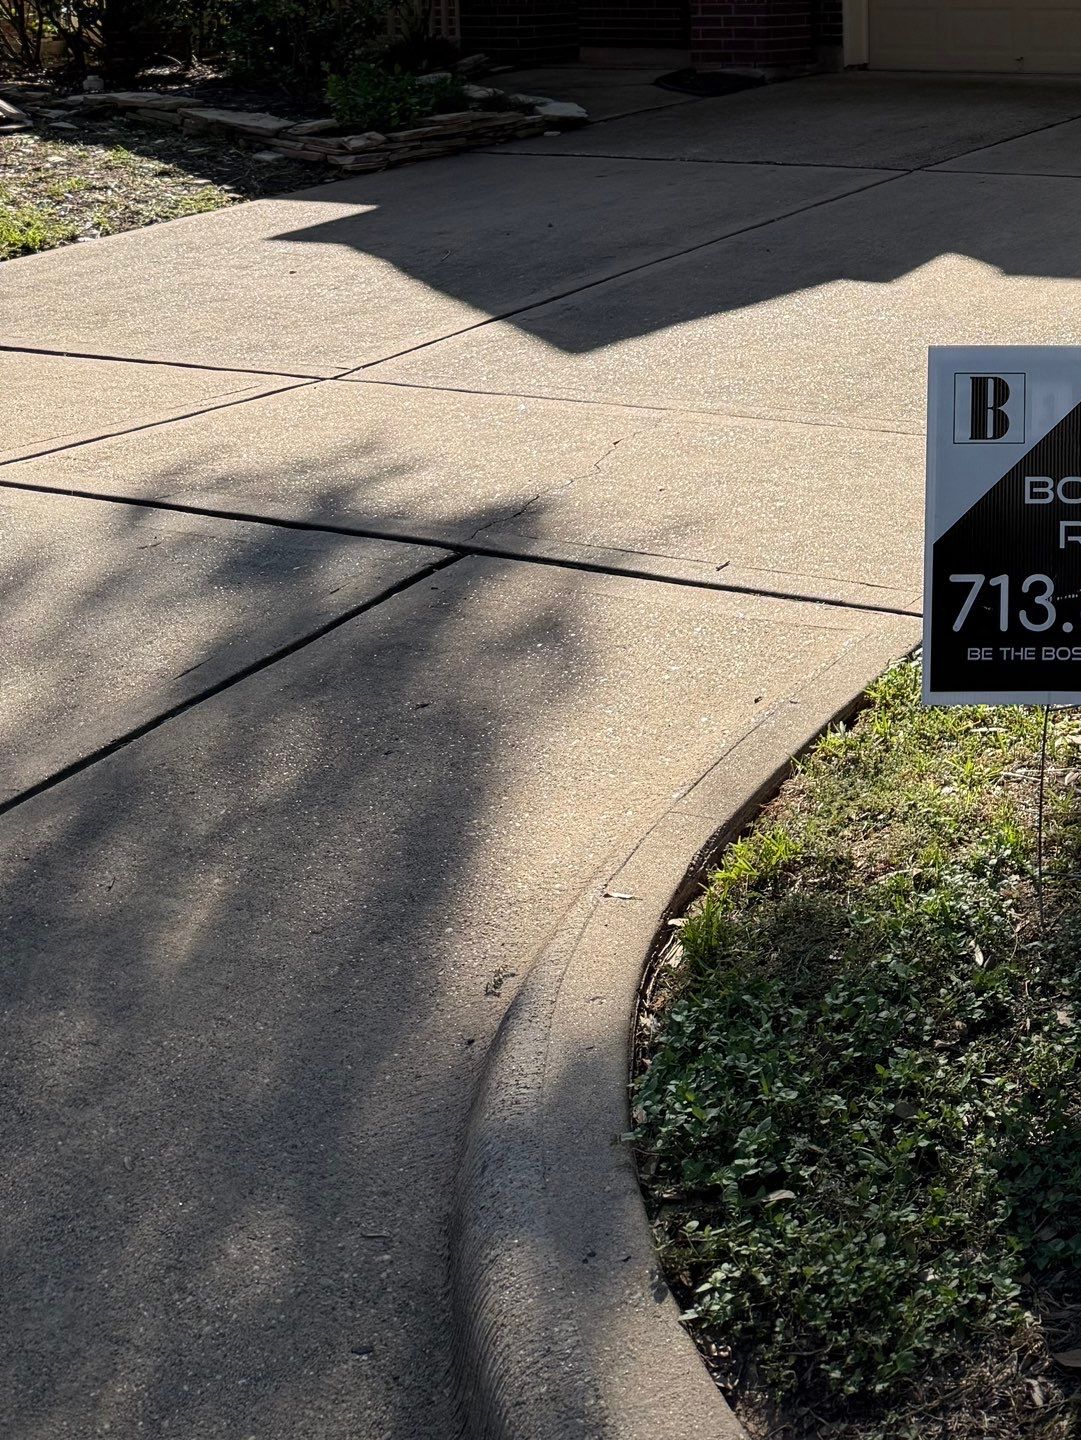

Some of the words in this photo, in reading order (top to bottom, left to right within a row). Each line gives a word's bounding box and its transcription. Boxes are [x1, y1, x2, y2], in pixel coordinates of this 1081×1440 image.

[969, 376, 1011, 441] B
[967, 647, 993, 661] BE
[999, 647, 1036, 661] THE
